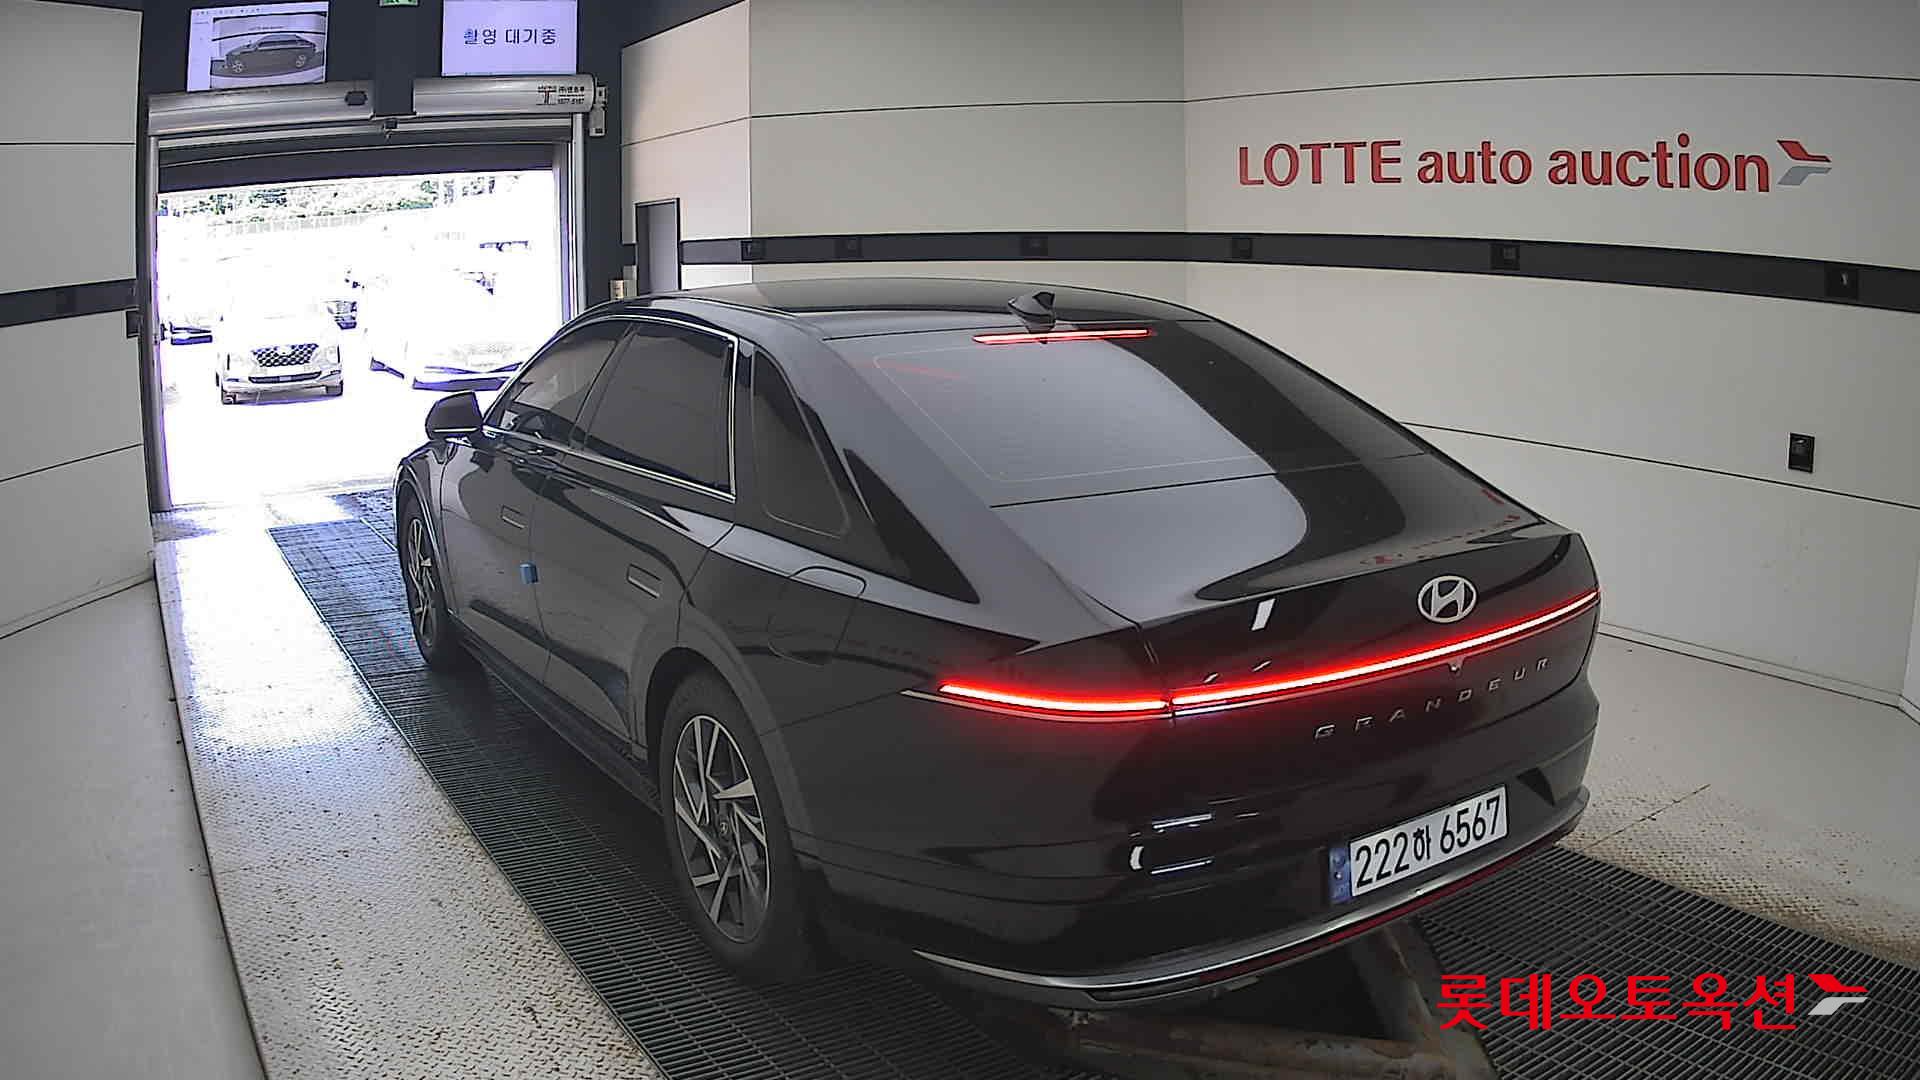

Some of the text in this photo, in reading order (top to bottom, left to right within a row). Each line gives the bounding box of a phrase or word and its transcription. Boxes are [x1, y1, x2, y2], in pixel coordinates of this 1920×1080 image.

[505, 28, 556, 45] 대기중
[1239, 133, 1770, 192] LOTTE auto auction
[1314, 657, 1550, 741] GRANDEUR
[1355, 796, 1501, 889] 222하 6567
